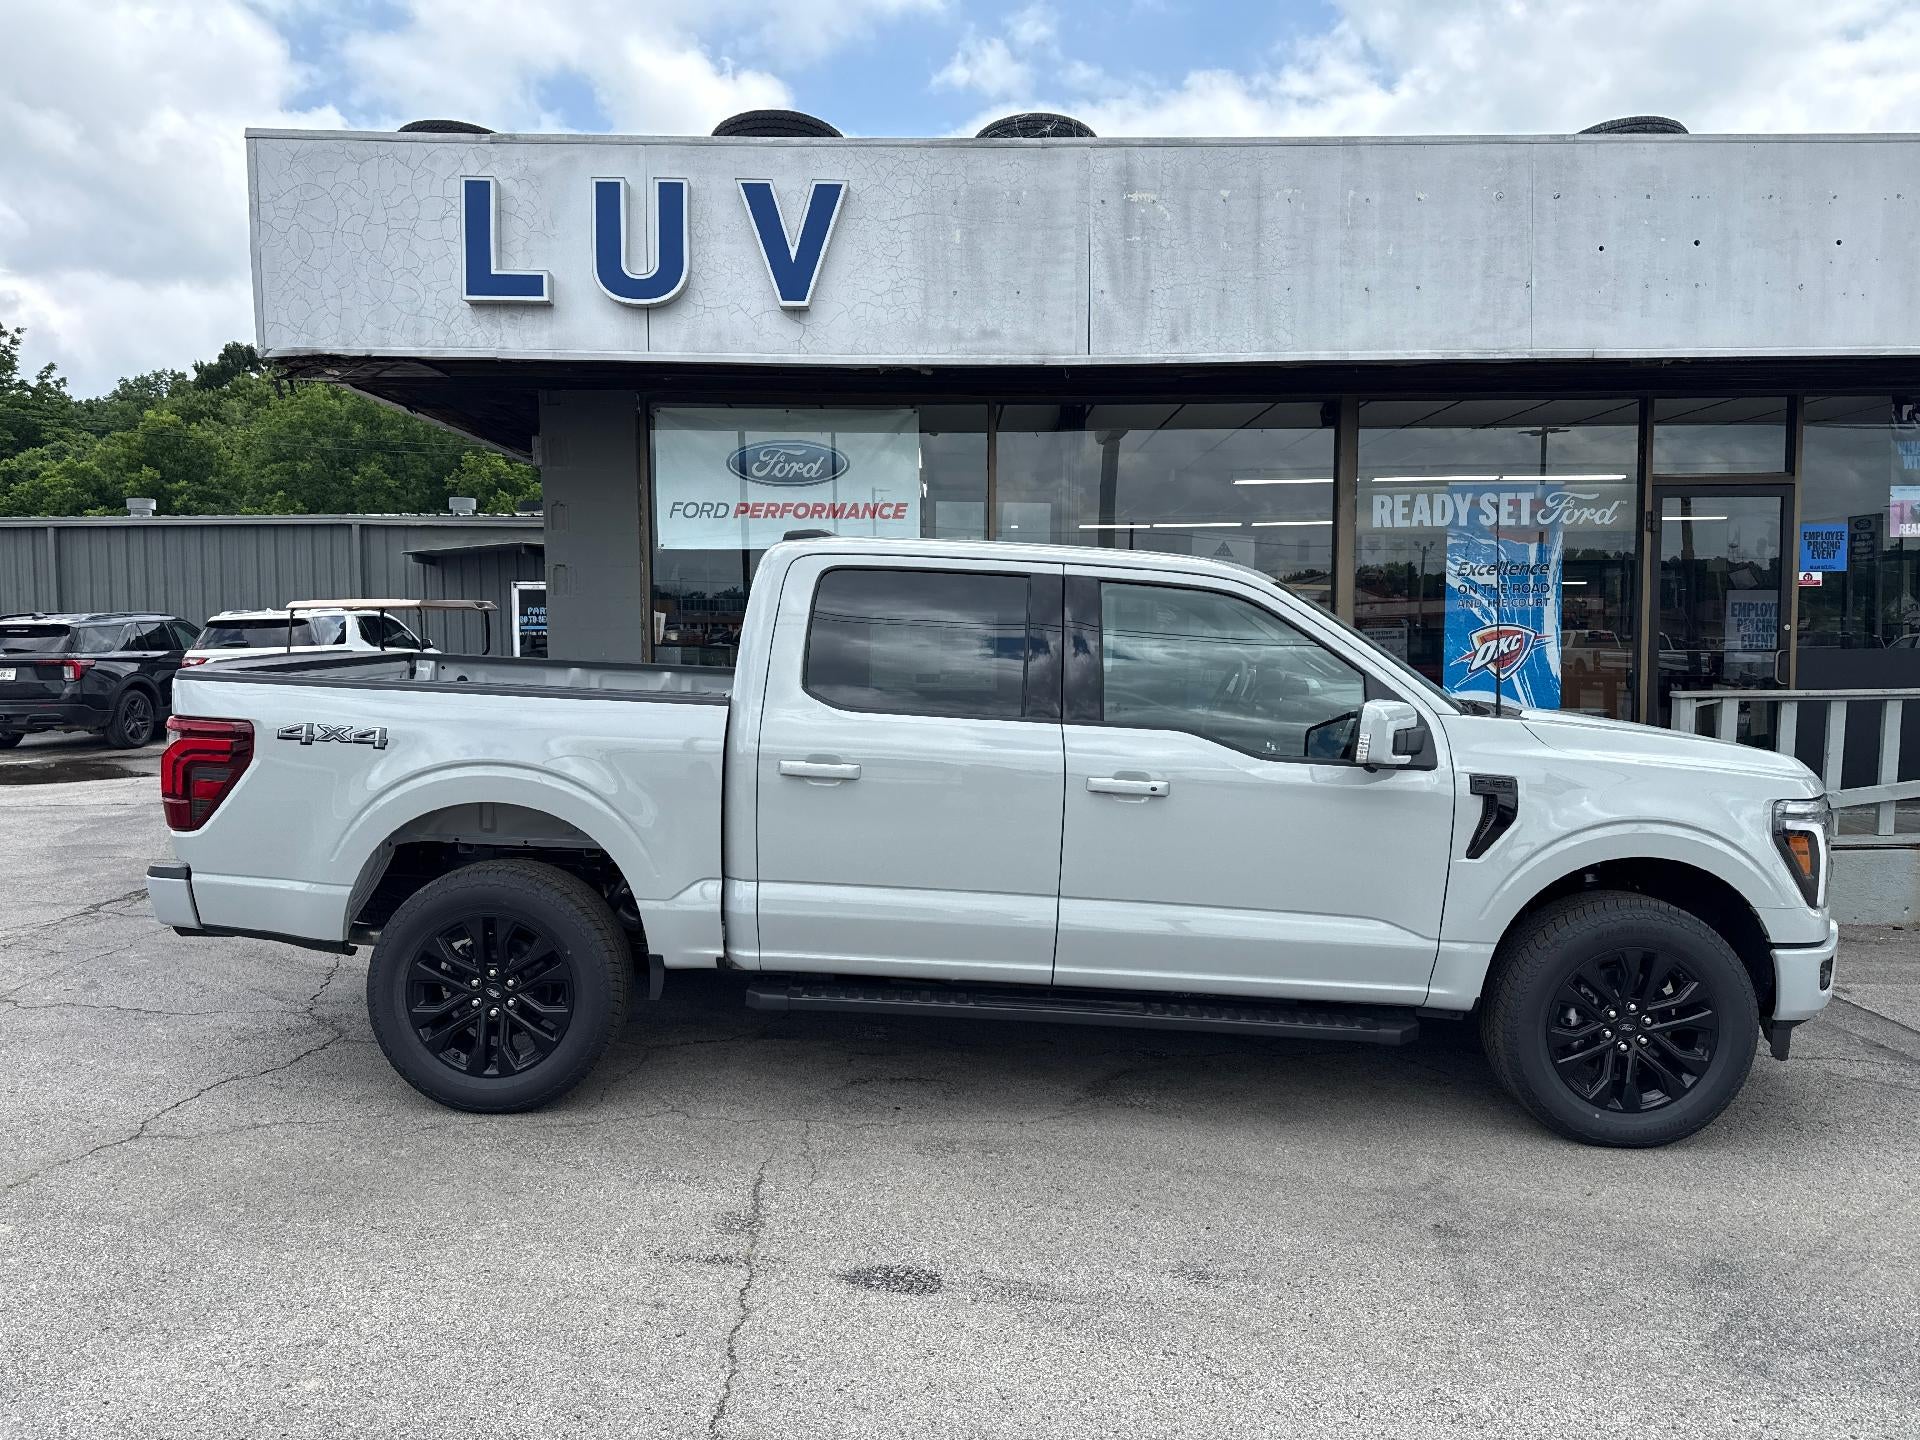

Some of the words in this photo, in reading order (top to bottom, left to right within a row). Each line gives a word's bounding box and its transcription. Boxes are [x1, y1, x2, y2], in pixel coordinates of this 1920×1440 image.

[751, 447, 824, 478] Ford
[669, 501, 730, 519] FORD
[733, 502, 908, 520] PERFORMANCE
[1372, 493, 1473, 528] READY
[1479, 492, 1535, 527] SET
[1537, 491, 1620, 525] Ford
[1803, 531, 1845, 540] EMPLOYEE
[1807, 540, 1840, 550] PRICING
[1811, 550, 1837, 559] EVENT
[1457, 561, 1550, 577] Excellence
[1457, 584, 1477, 595] ON
[1482, 584, 1508, 594] THE
[1512, 583, 1550, 594] ROAD
[1457, 599, 1482, 609] AND
[1487, 598, 1508, 608] THE
[1511, 598, 1550, 608] COURT
[1470, 634, 1522, 671] OKC
